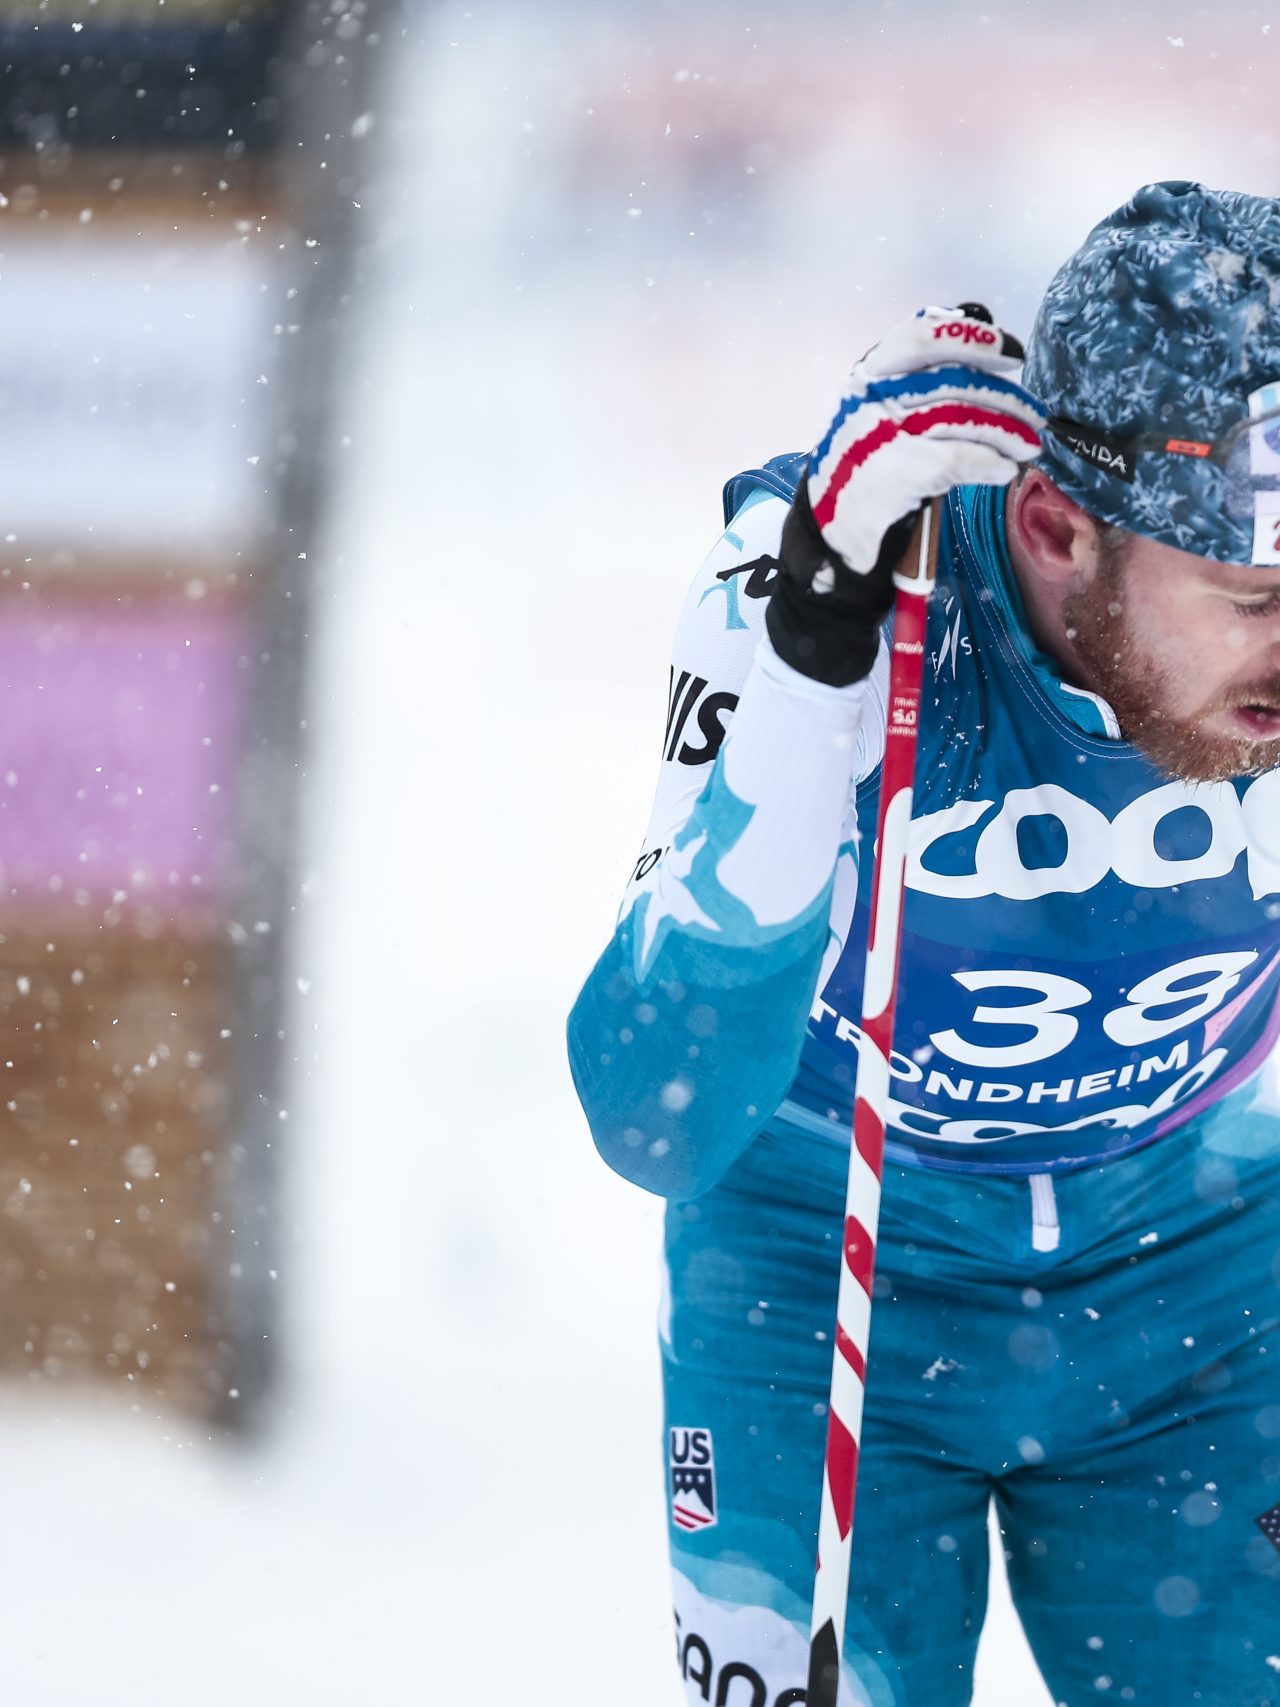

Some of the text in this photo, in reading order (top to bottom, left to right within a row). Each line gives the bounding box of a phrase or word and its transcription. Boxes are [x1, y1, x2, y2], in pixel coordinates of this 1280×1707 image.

[933, 322, 996, 345] TOKO
[930, 951, 1259, 1068] 38
[672, 1431, 710, 1465] US
